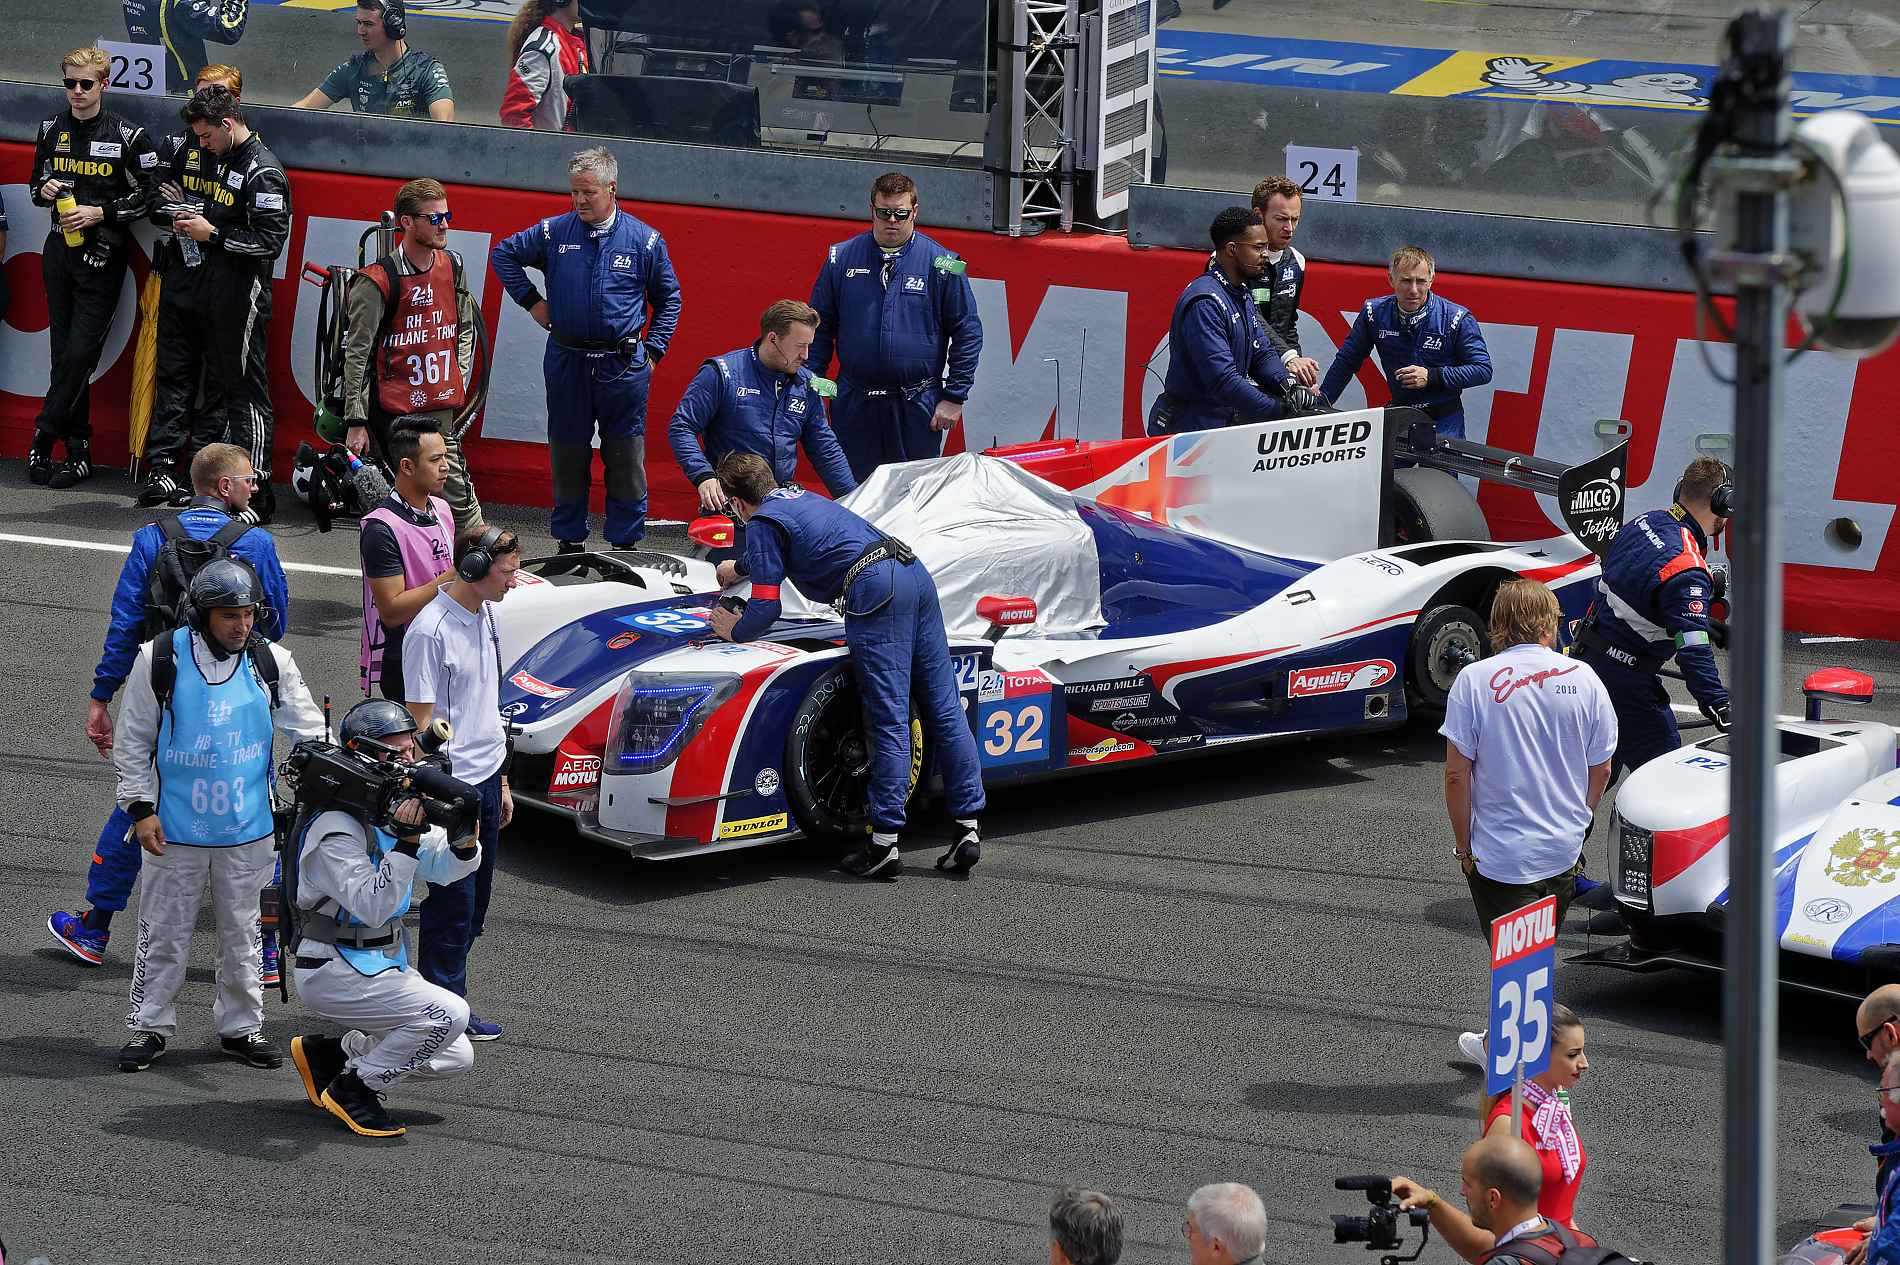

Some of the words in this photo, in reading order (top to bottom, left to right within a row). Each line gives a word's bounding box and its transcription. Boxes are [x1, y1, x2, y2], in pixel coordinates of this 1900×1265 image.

[111, 56, 153, 91] 23
[53, 157, 113, 177] JUMBO
[1300, 161, 1346, 196] 24
[406, 314, 422, 330] RH
[432, 309, 443, 326] TV
[1424, 336, 1443, 348] 24h
[407, 349, 451, 386] 367
[1257, 421, 1372, 455] UNITED
[1252, 446, 1367, 473] AUTOSPORTS
[1571, 488, 1611, 510] MMCG
[713, 533, 727, 541] 46
[1580, 516, 1620, 542] Jetfly
[1356, 556, 1402, 576] AERO
[1000, 609, 1033, 620] MOTUL
[1606, 646, 1637, 667] MRTC
[1007, 675, 1050, 688] TOTAL
[1064, 682, 1111, 694] RICHARD
[1113, 677, 1145, 690] MILLE
[1293, 671, 1352, 692] Aguila
[1556, 684, 1577, 695] 2018
[227, 730, 241, 748] TV
[983, 705, 1043, 757] 32
[165, 749, 217, 769] PITLANE
[232, 740, 264, 765] TRACK
[1069, 742, 1135, 756] motorsport.com
[561, 759, 601, 772] AERO
[1685, 757, 1728, 770] P2
[554, 770, 598, 786] MOTUL
[191, 777, 245, 816] 683
[731, 818, 784, 833] DUNLOP
[1495, 904, 1556, 961] MOTUL
[1495, 966, 1549, 1076] 35
